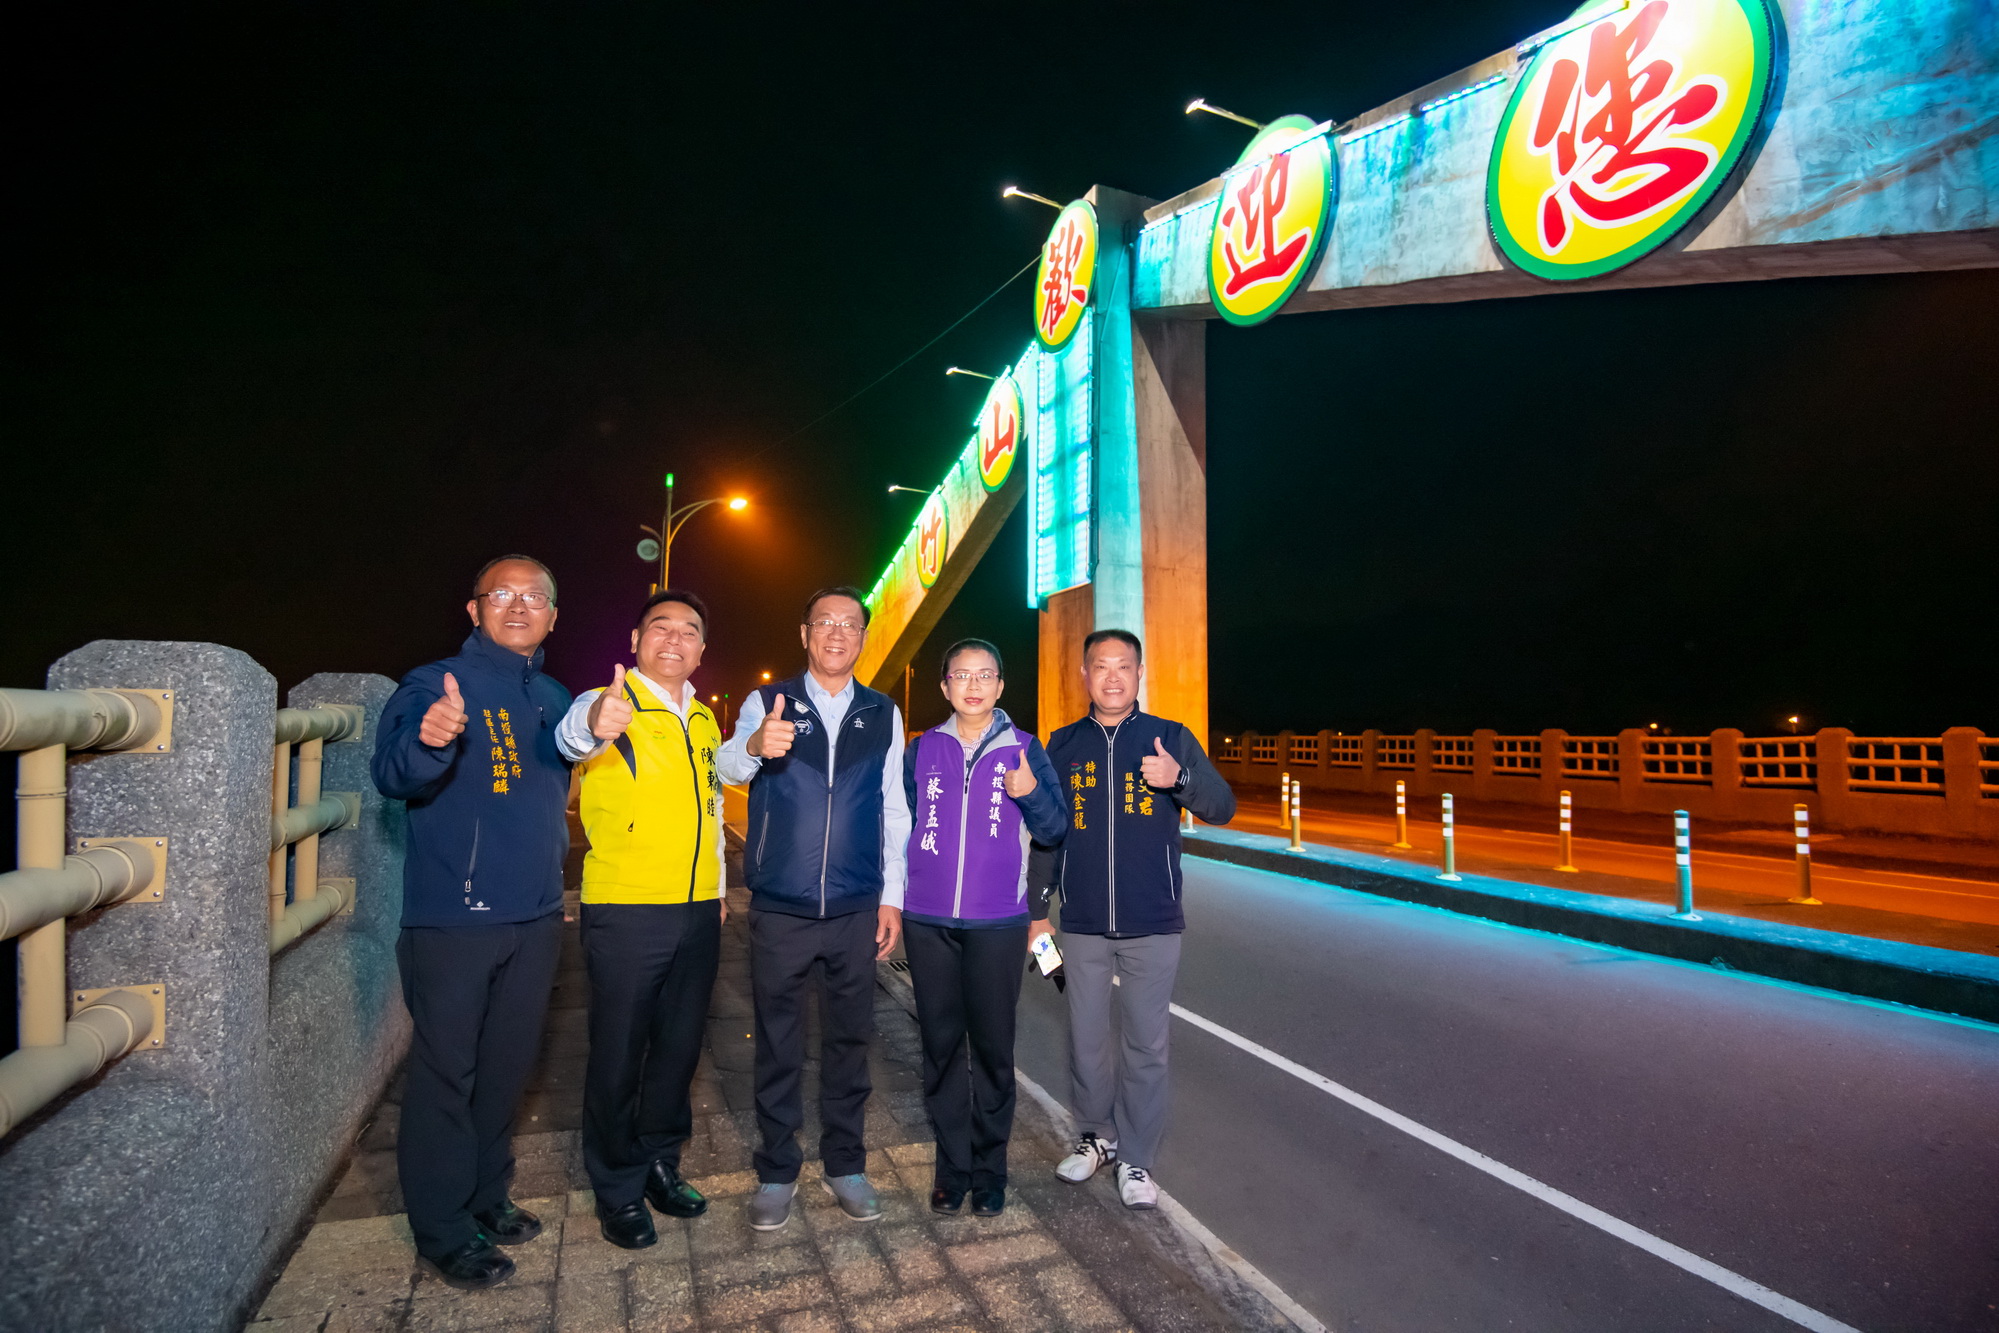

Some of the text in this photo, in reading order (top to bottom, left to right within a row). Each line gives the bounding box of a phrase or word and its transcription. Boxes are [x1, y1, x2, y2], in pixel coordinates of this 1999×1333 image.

[1533, 0, 1719, 248] 您
[1221, 152, 1309, 297] 迎
[1041, 218, 1087, 337] 歡
[983, 400, 1016, 473] 山
[920, 505, 943, 575] 竹
[498, 707, 522, 779] 南投縣政府
[1085, 760, 1097, 788] 特助
[920, 776, 944, 856] 蔡孟娥
[988, 761, 1007, 839] 南投縣議員
[1070, 772, 1087, 830] 陳金龍
[1124, 772, 1136, 815] 服務團隊
